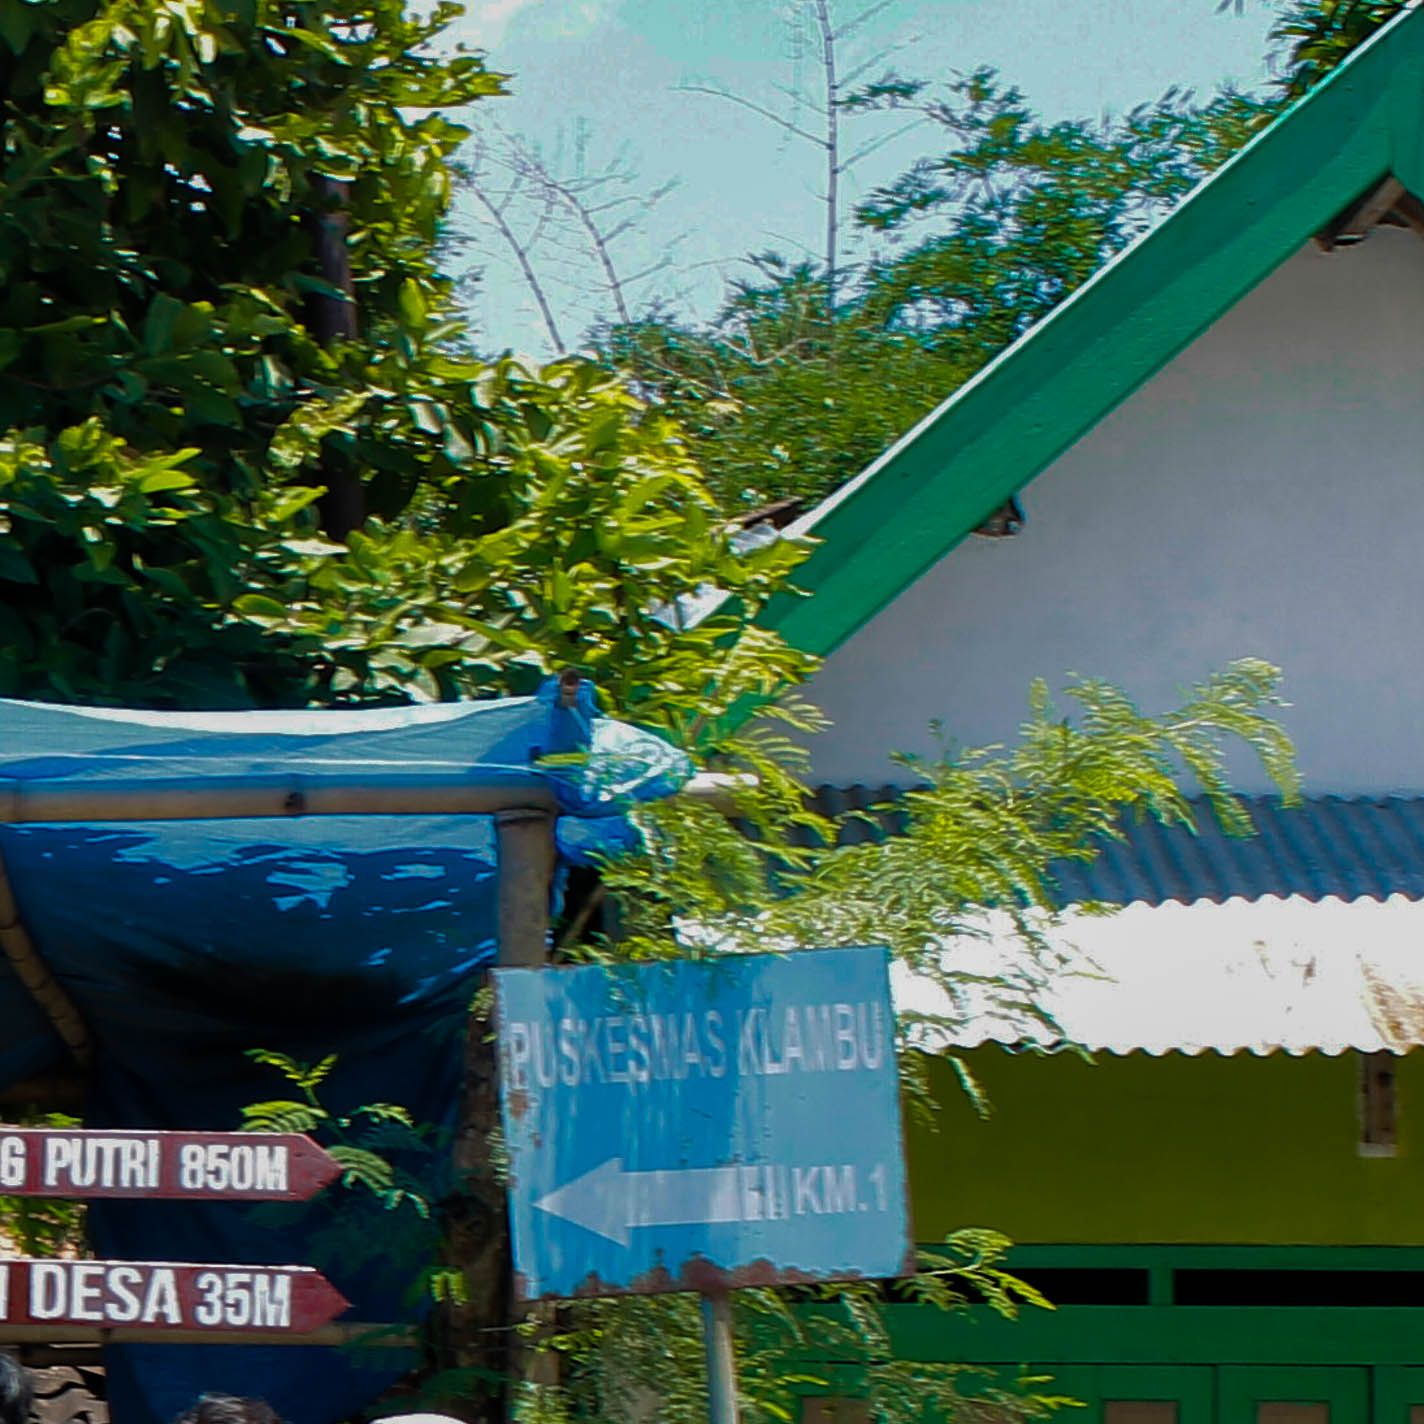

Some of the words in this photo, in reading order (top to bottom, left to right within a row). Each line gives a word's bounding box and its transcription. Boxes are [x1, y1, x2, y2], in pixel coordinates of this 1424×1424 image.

[507, 1008, 726, 1090] PUSKESMAS
[737, 1000, 883, 1077] KLAMBU
[45, 1136, 160, 1189] PUTRI
[181, 1144, 289, 1192] 850M
[30, 1263, 183, 1324] DESA
[195, 1271, 292, 1328] 35M
